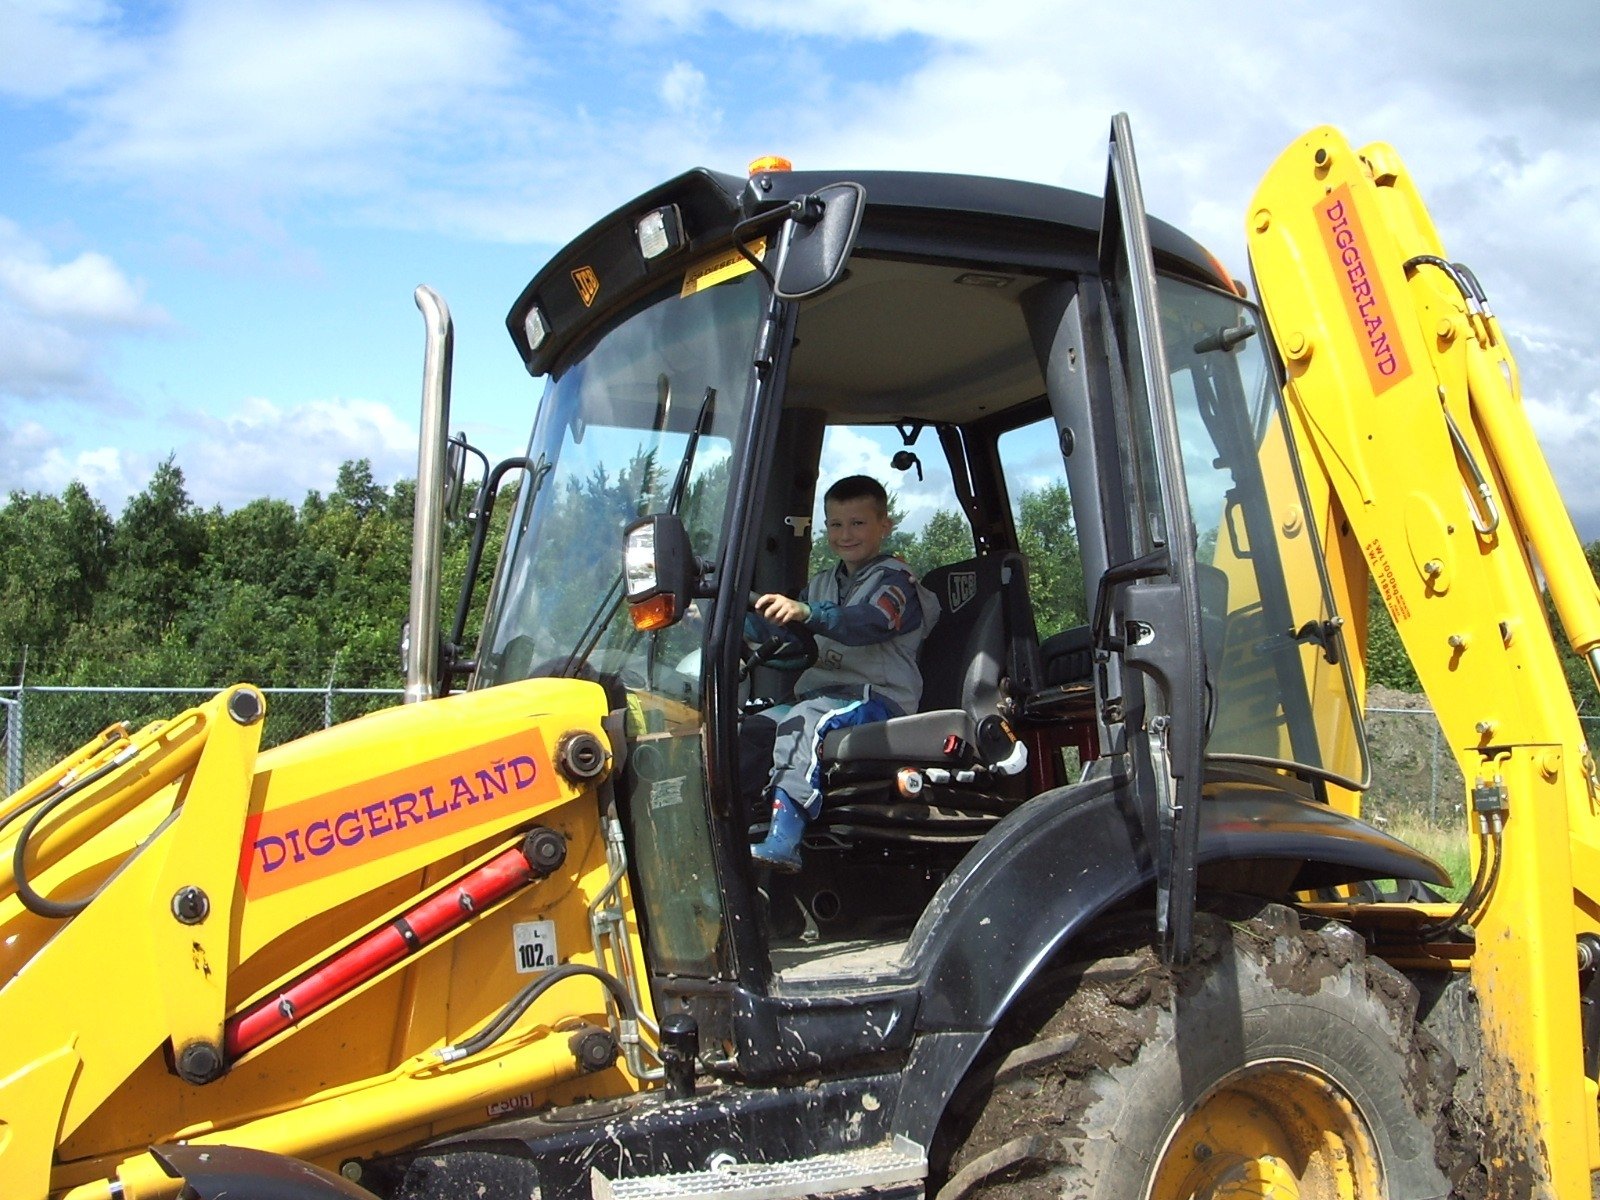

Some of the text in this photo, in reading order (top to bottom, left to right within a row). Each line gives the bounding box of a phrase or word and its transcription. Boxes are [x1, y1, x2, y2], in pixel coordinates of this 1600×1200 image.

[574, 268, 597, 302] JCB
[1326, 200, 1397, 376] DIGGERLAND
[1366, 543, 1379, 567] SWL
[1372, 539, 1385, 560] SWL
[952, 574, 977, 607] JCB
[253, 755, 537, 873] DIGGERLAND
[519, 943, 545, 968] 102
